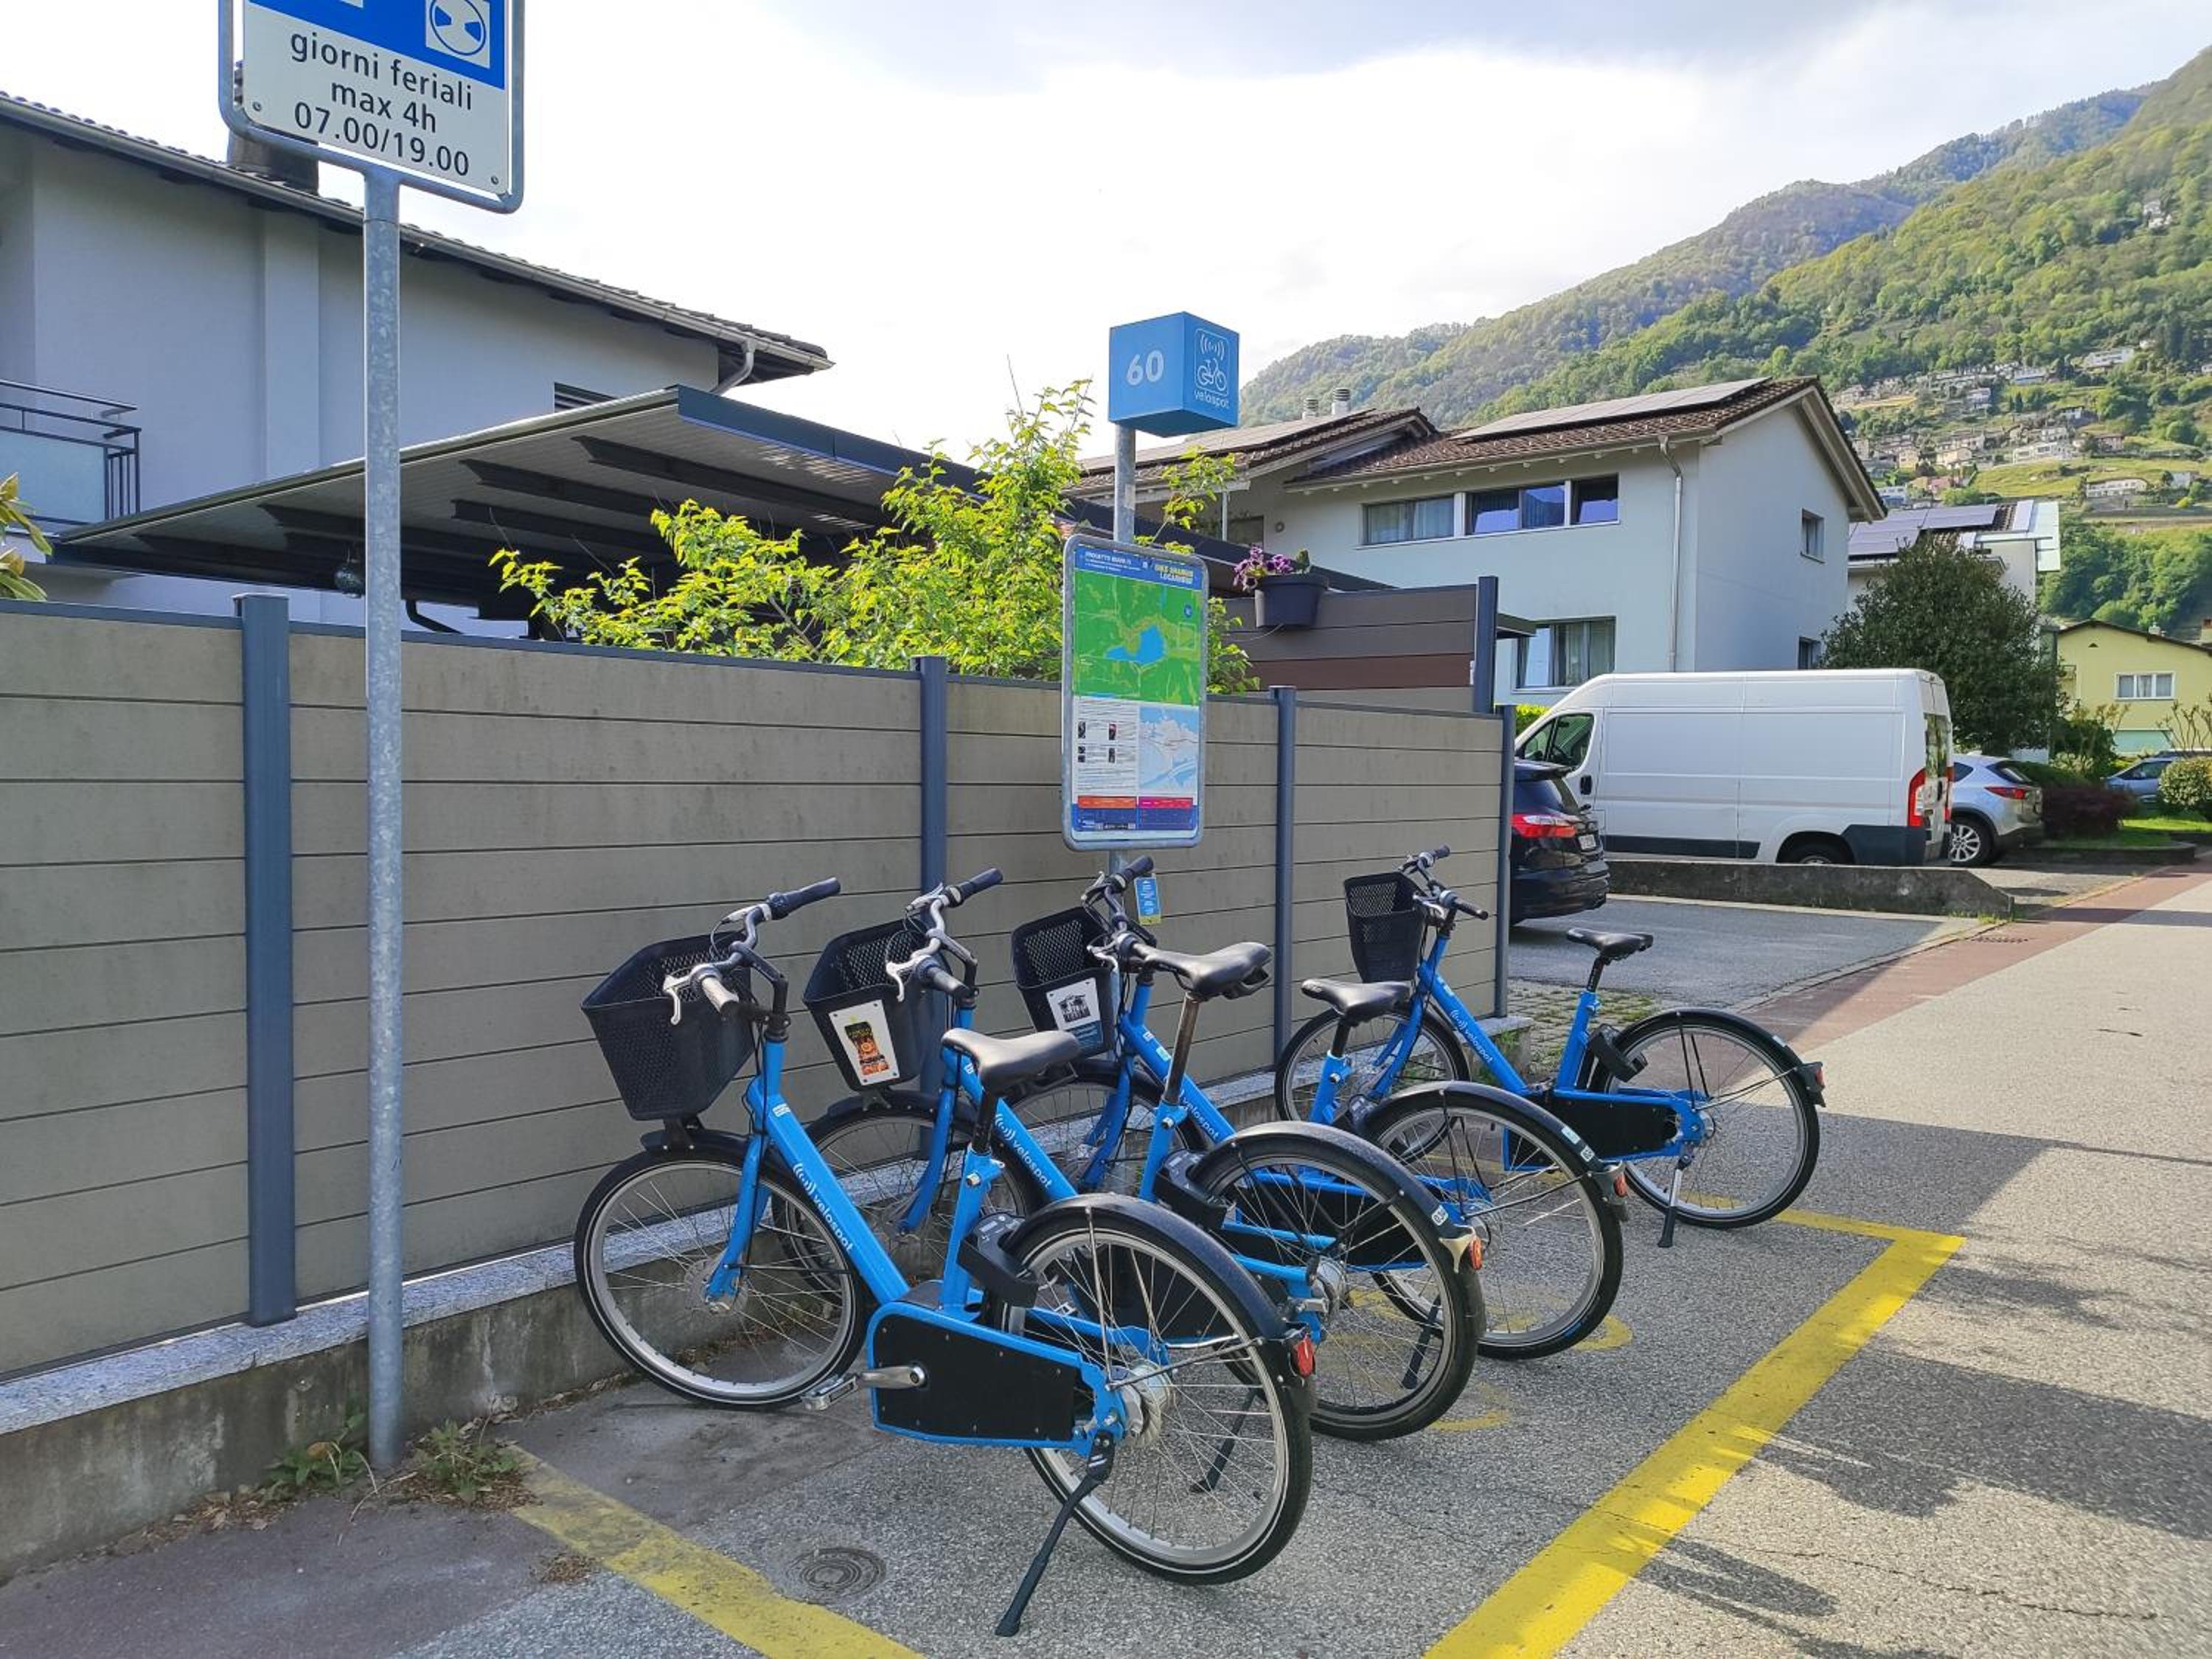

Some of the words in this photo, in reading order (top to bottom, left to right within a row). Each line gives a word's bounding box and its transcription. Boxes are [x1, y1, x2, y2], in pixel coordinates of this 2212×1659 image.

[291, 32, 379, 79] giorni
[390, 59, 473, 110] feriali
[331, 82, 392, 119] max
[403, 102, 437, 133] 4h
[294, 102, 470, 176] 07.00/19.00
[1126, 350, 1164, 386] 60
[1183, 1097, 1219, 1140] velospot
[1013, 1141, 1052, 1189] velospot
[814, 1192, 855, 1251] velospot
